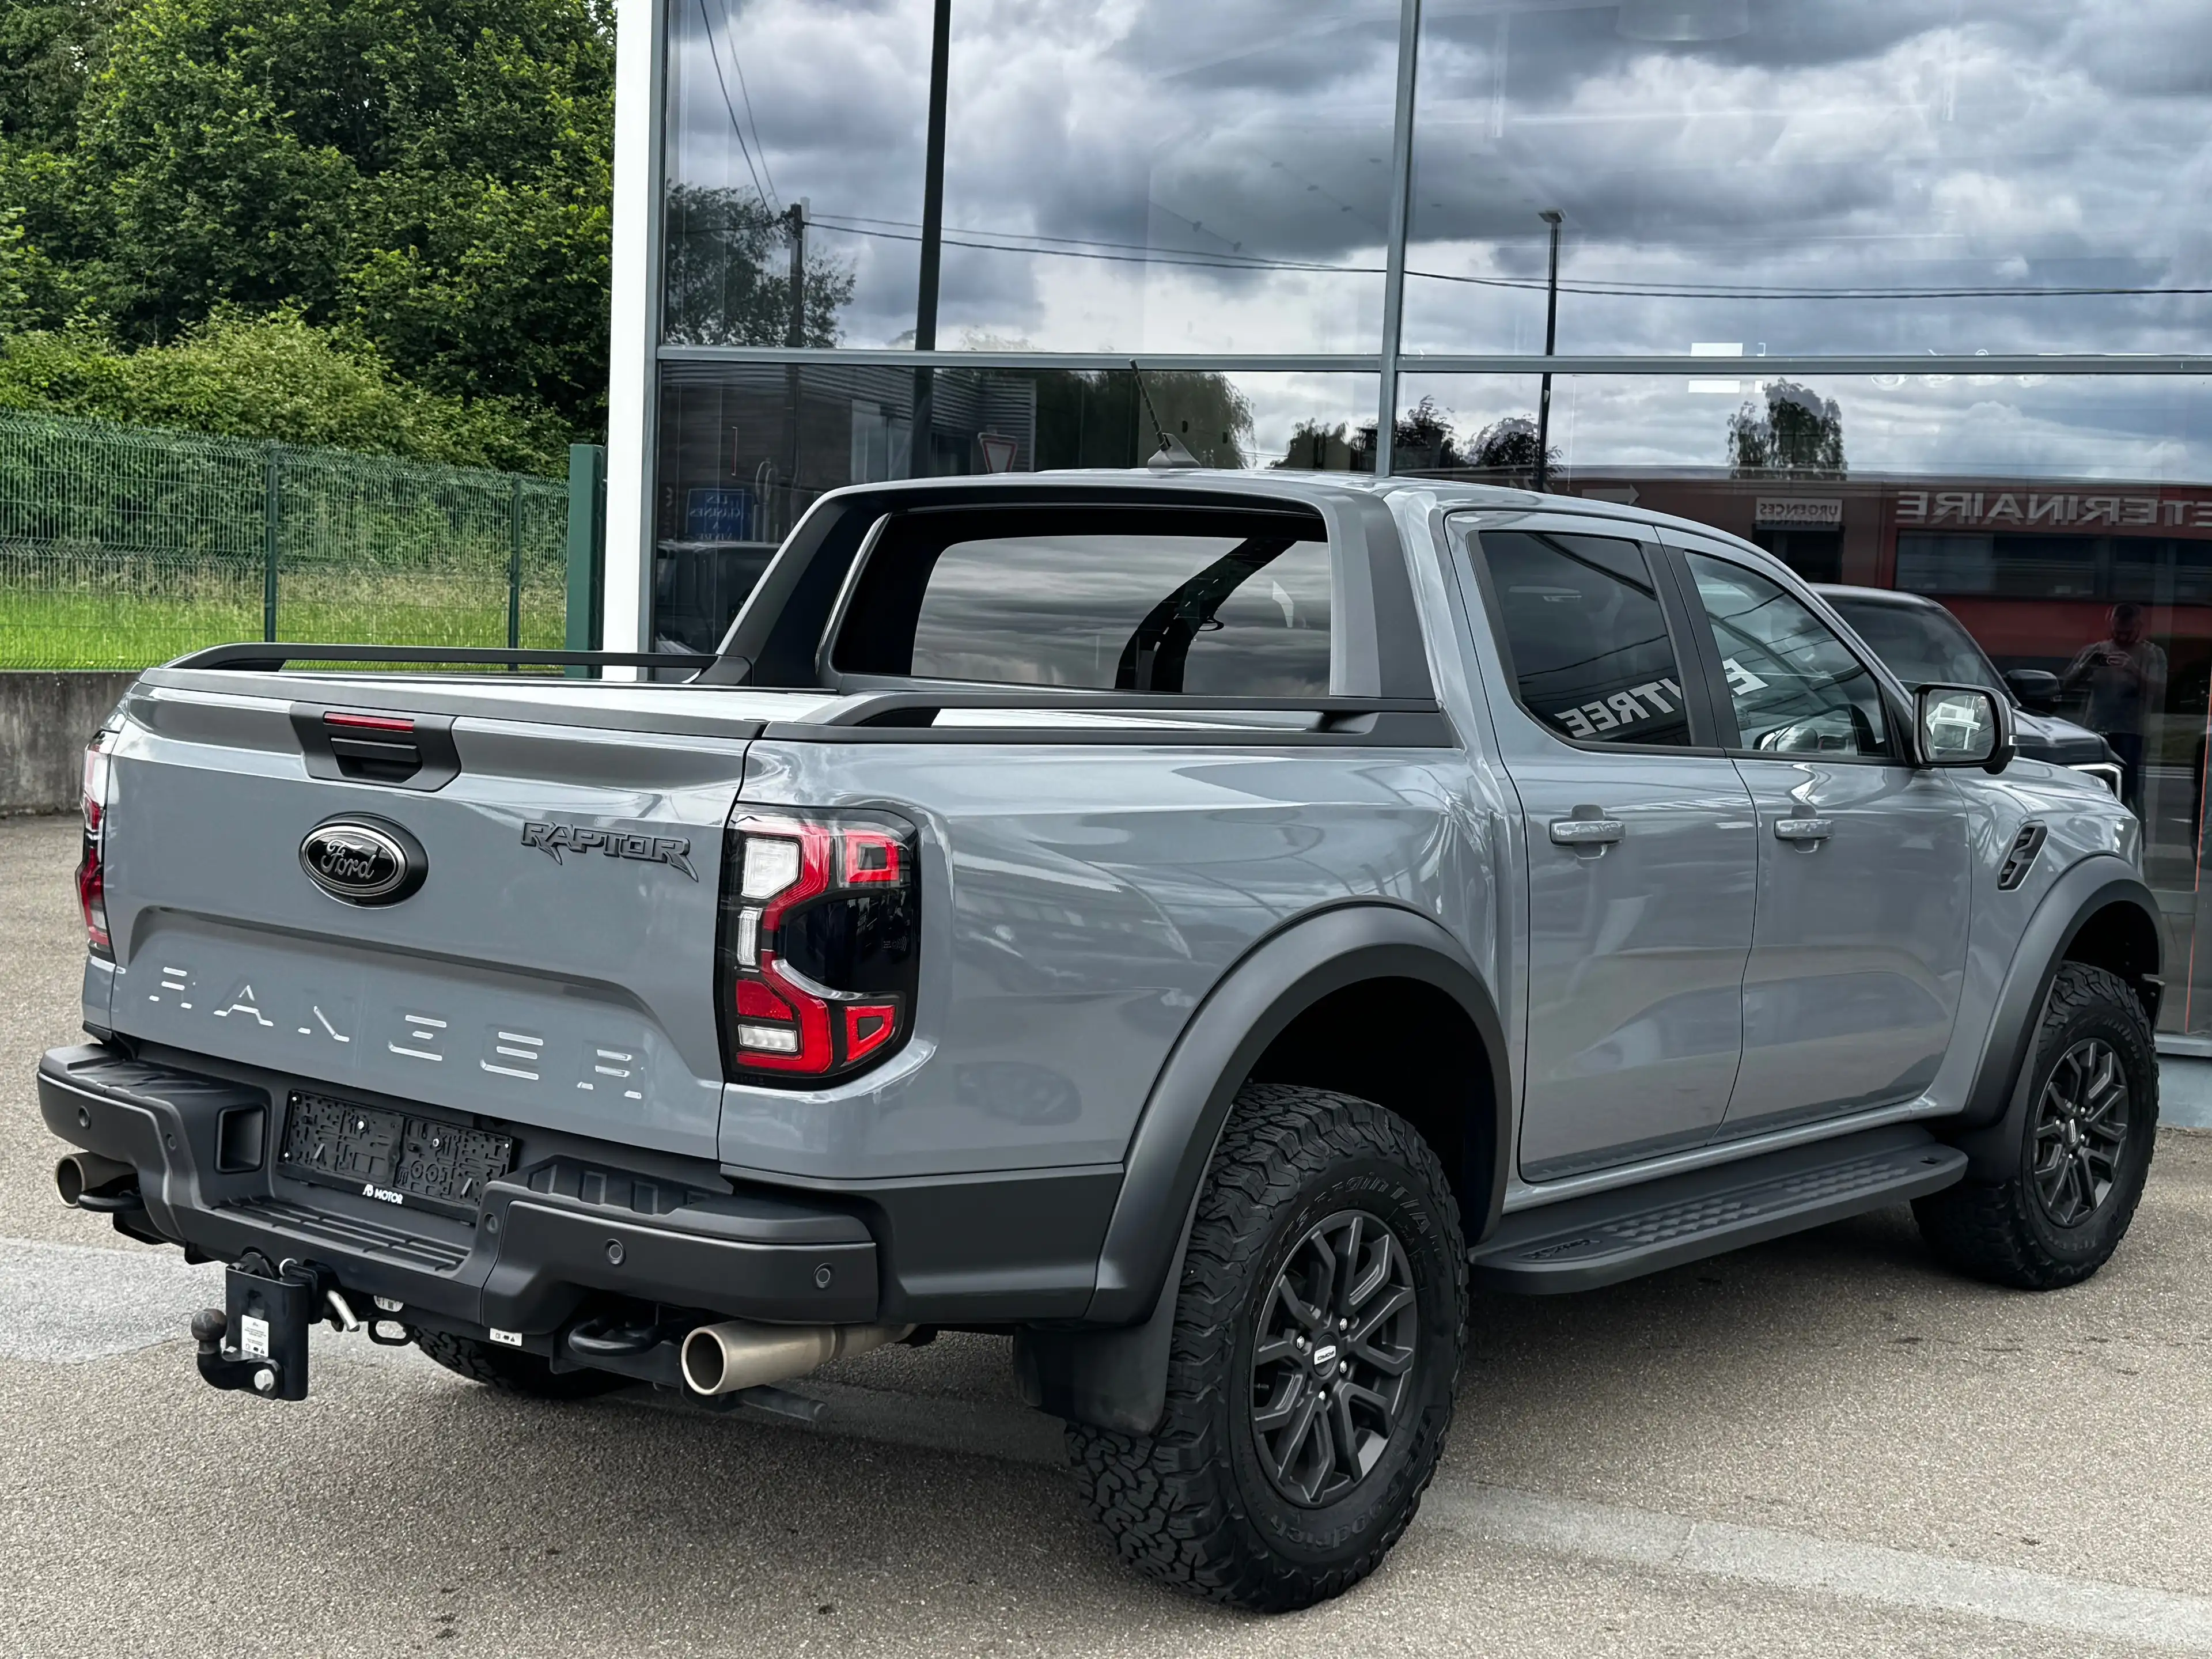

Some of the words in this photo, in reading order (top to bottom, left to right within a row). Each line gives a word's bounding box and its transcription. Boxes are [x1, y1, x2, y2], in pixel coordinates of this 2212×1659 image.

[320, 839, 376, 880] Ford
[521, 820, 699, 882] RAPTOR
[148, 966, 646, 1100] RANGER
[374, 1188, 403, 1204] MOTOR
